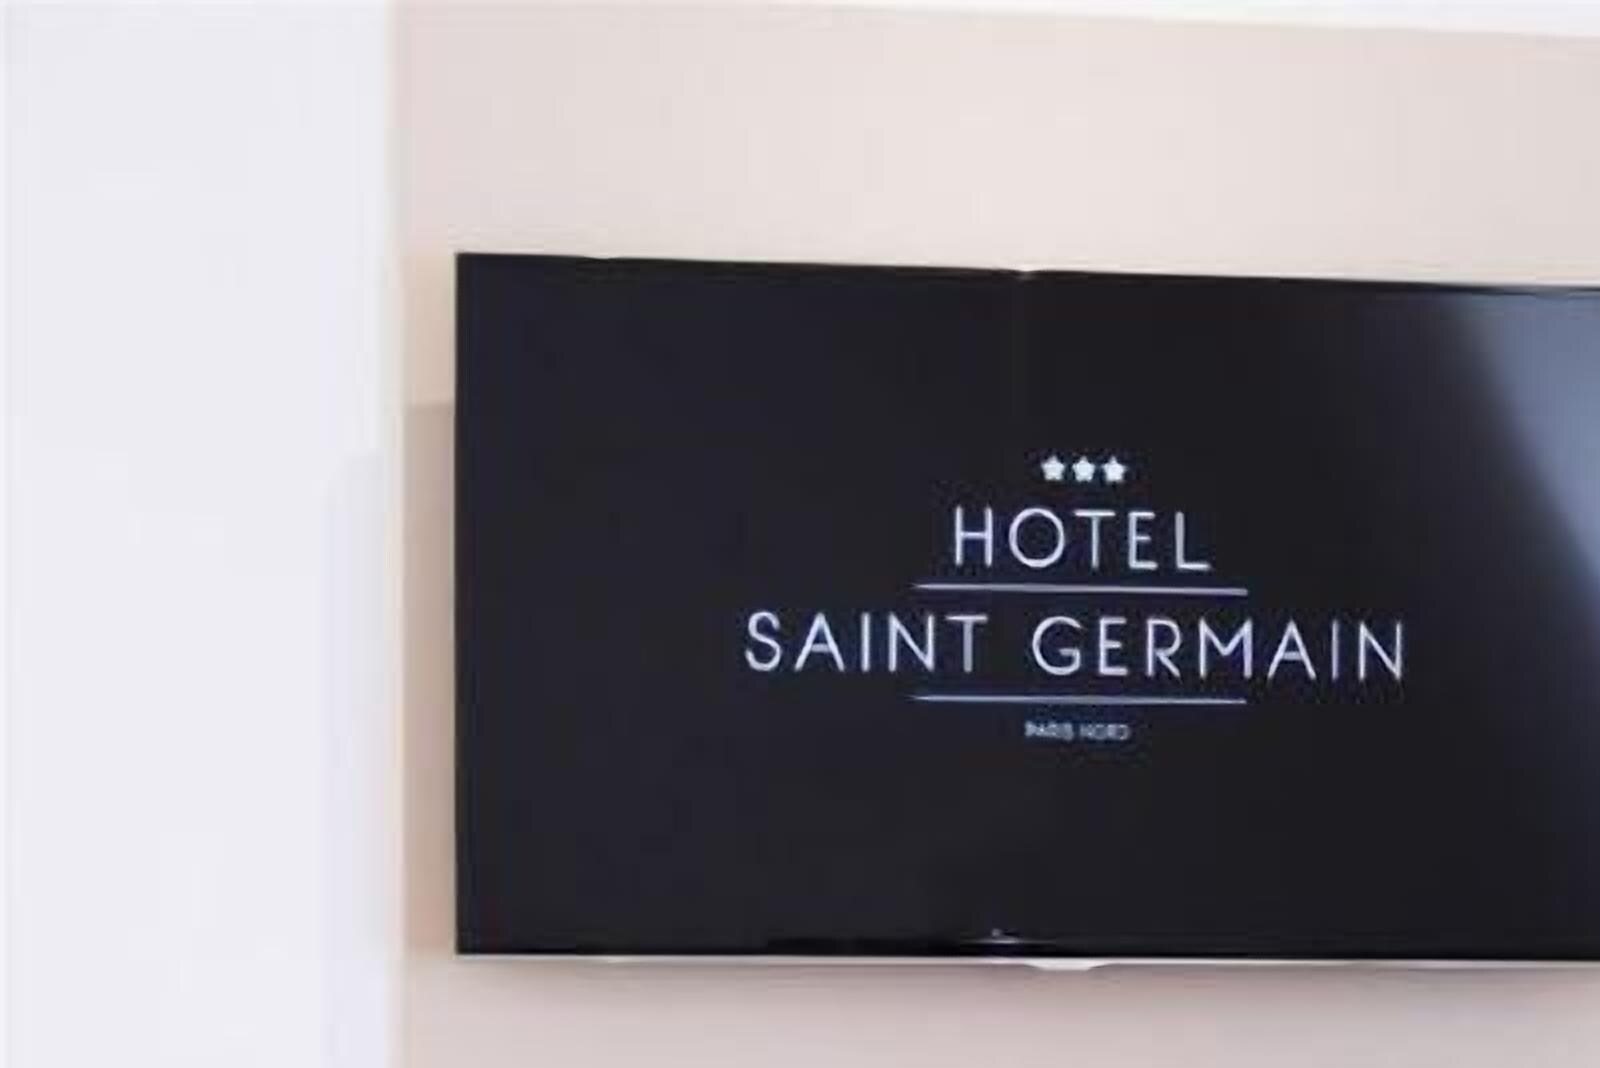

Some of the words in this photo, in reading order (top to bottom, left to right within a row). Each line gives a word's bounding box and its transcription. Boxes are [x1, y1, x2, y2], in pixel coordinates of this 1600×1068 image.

[955, 505, 1212, 569] HOTEL
[745, 611, 991, 673] SAINT
[1032, 615, 1404, 680] GERMAIN
